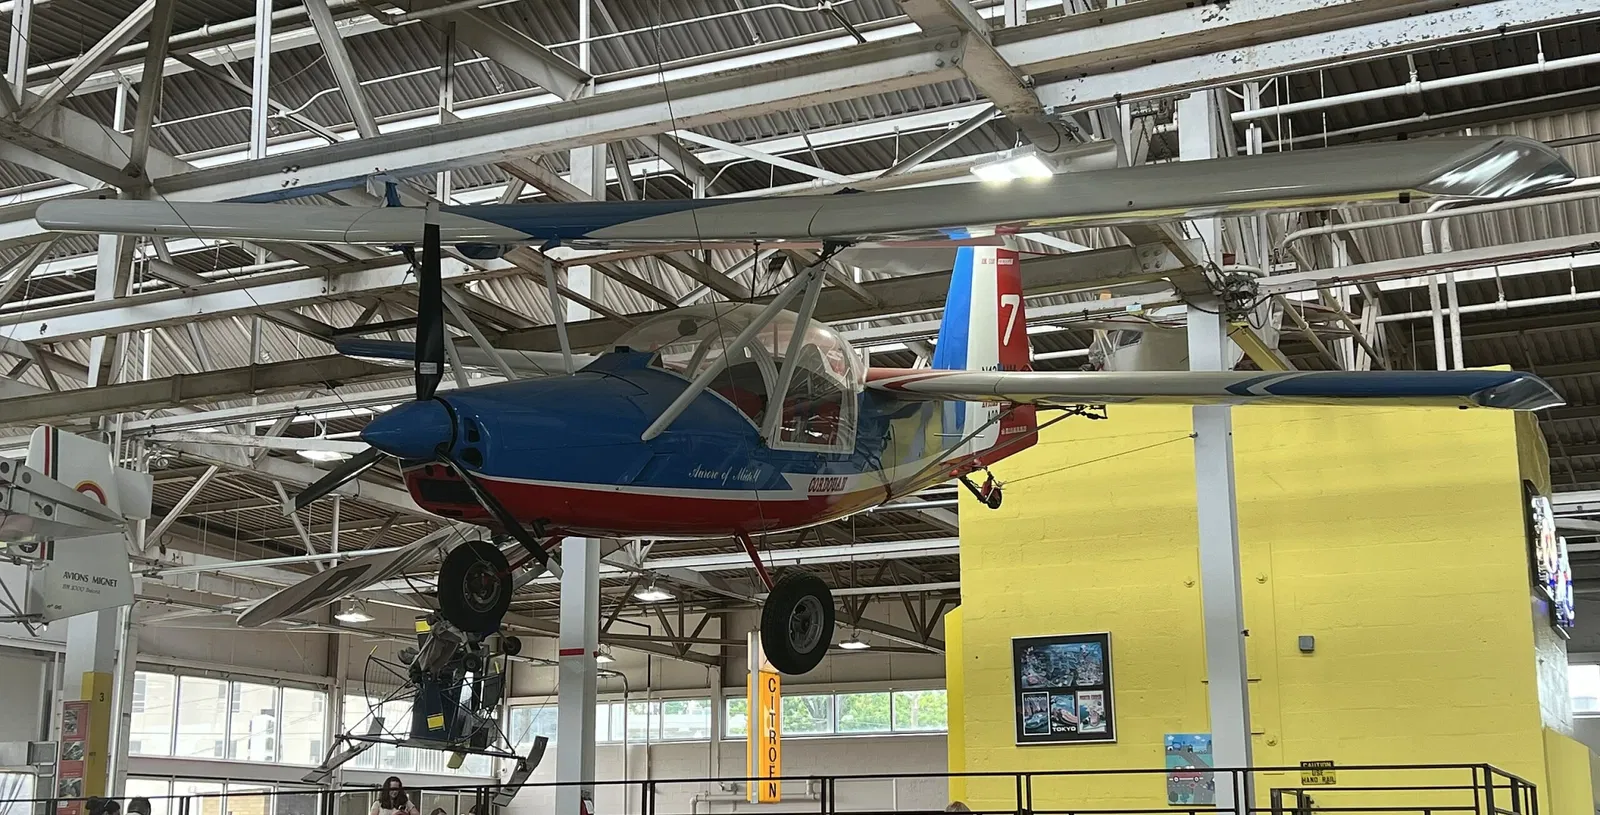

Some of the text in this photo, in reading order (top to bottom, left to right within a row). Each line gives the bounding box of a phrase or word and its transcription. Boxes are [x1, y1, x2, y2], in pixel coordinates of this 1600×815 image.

[1001, 294, 1020, 347] 7
[721, 466, 733, 486] of
[63, 571, 118, 587] AVIONS MIGNET
[99, 692, 105, 702] 3
